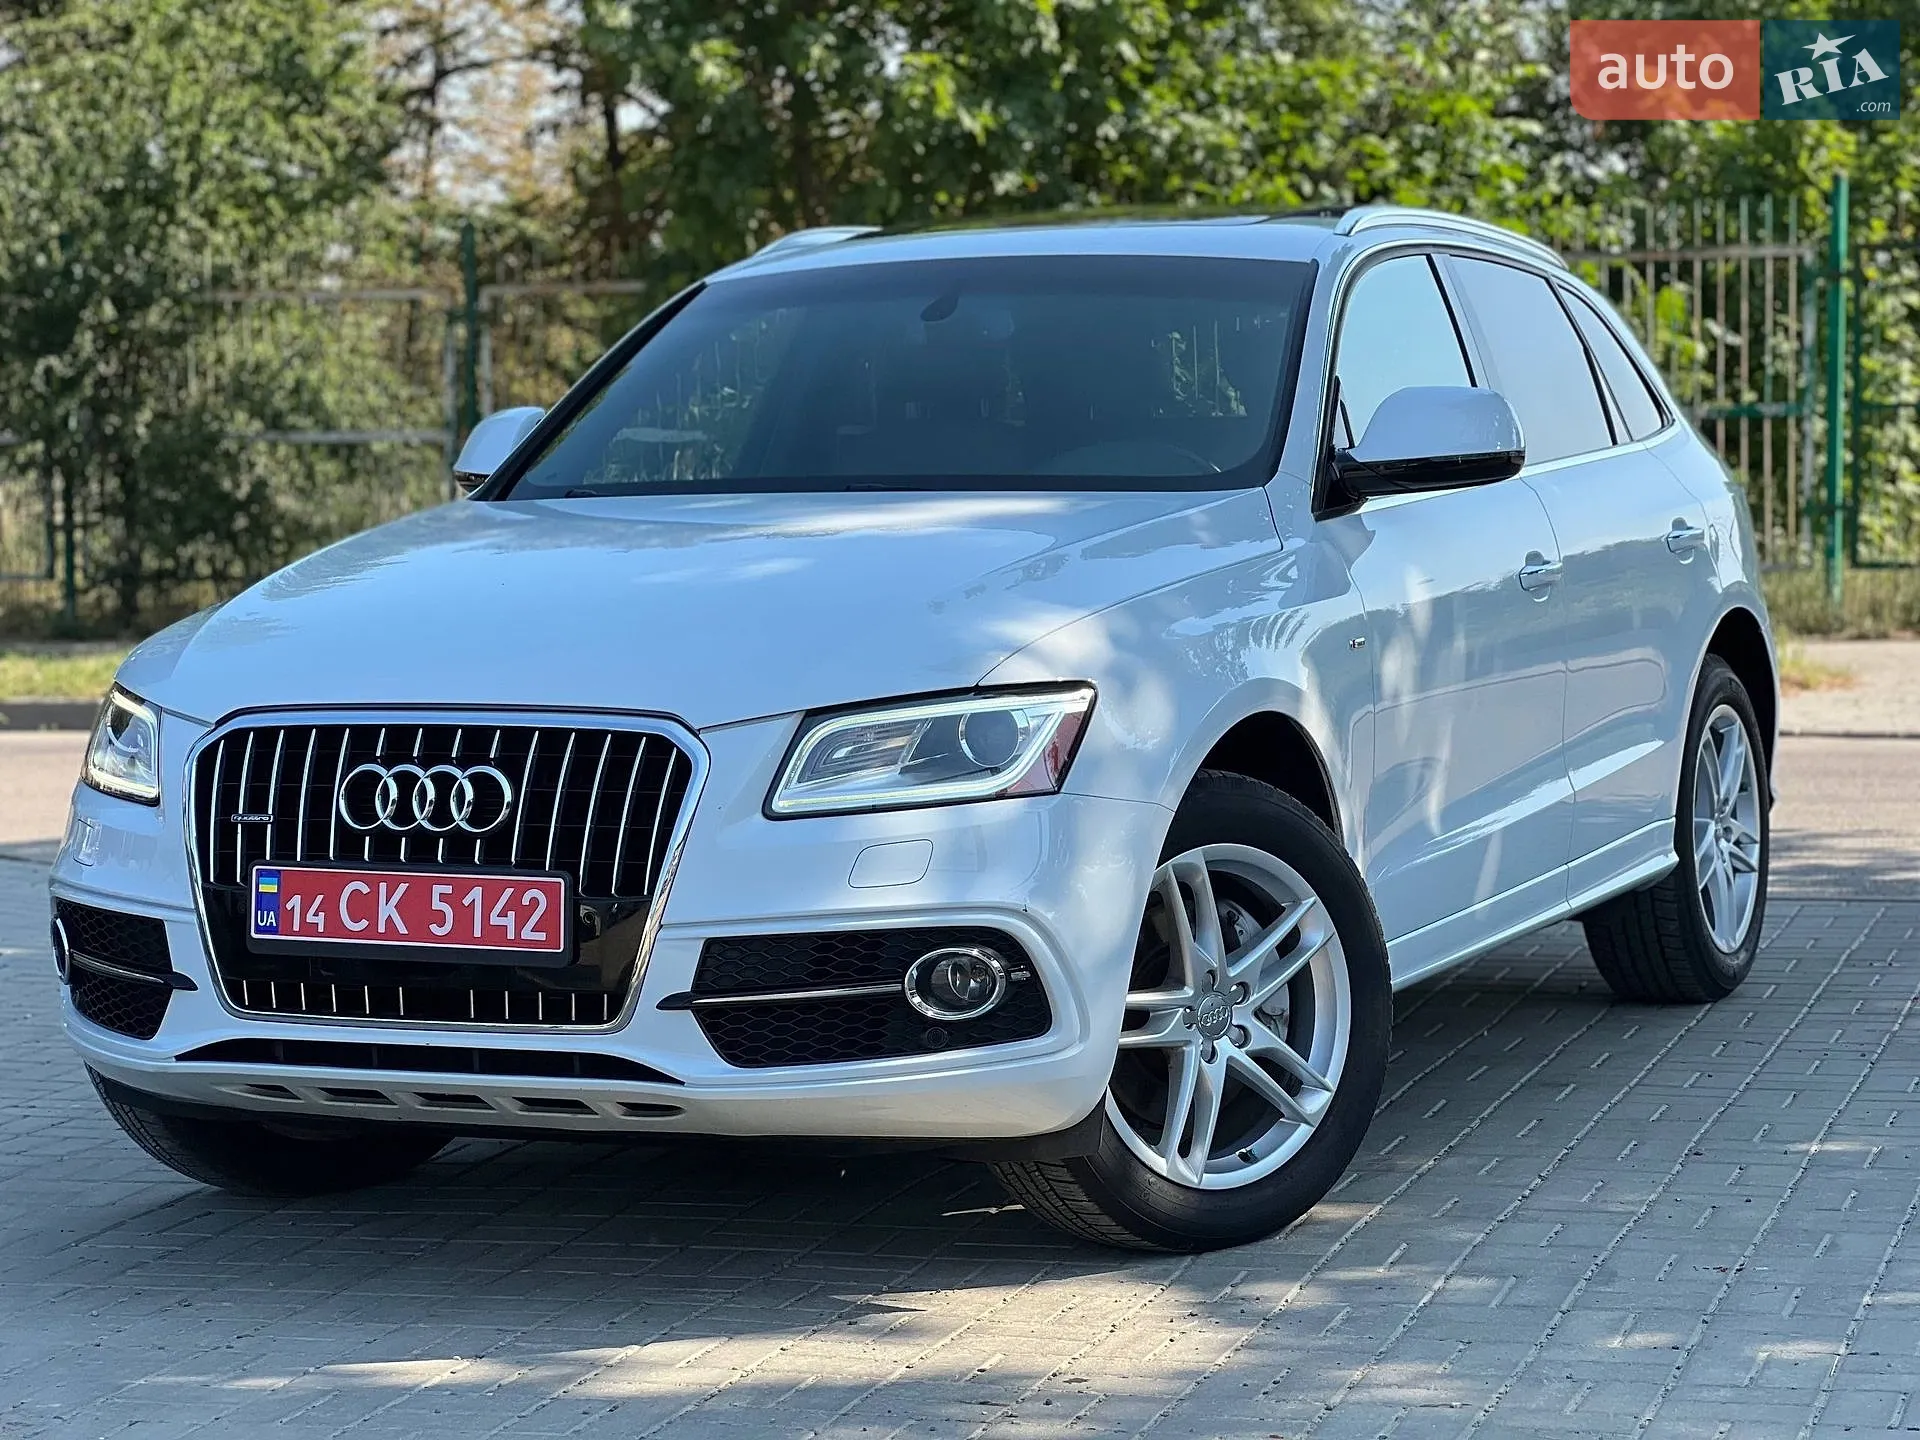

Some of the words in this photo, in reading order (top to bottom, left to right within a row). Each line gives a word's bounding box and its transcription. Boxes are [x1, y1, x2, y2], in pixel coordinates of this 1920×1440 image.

[257, 910, 277, 927] UA
[285, 894, 324, 933] 14
[339, 881, 409, 935] CK
[428, 884, 548, 941] 5142
